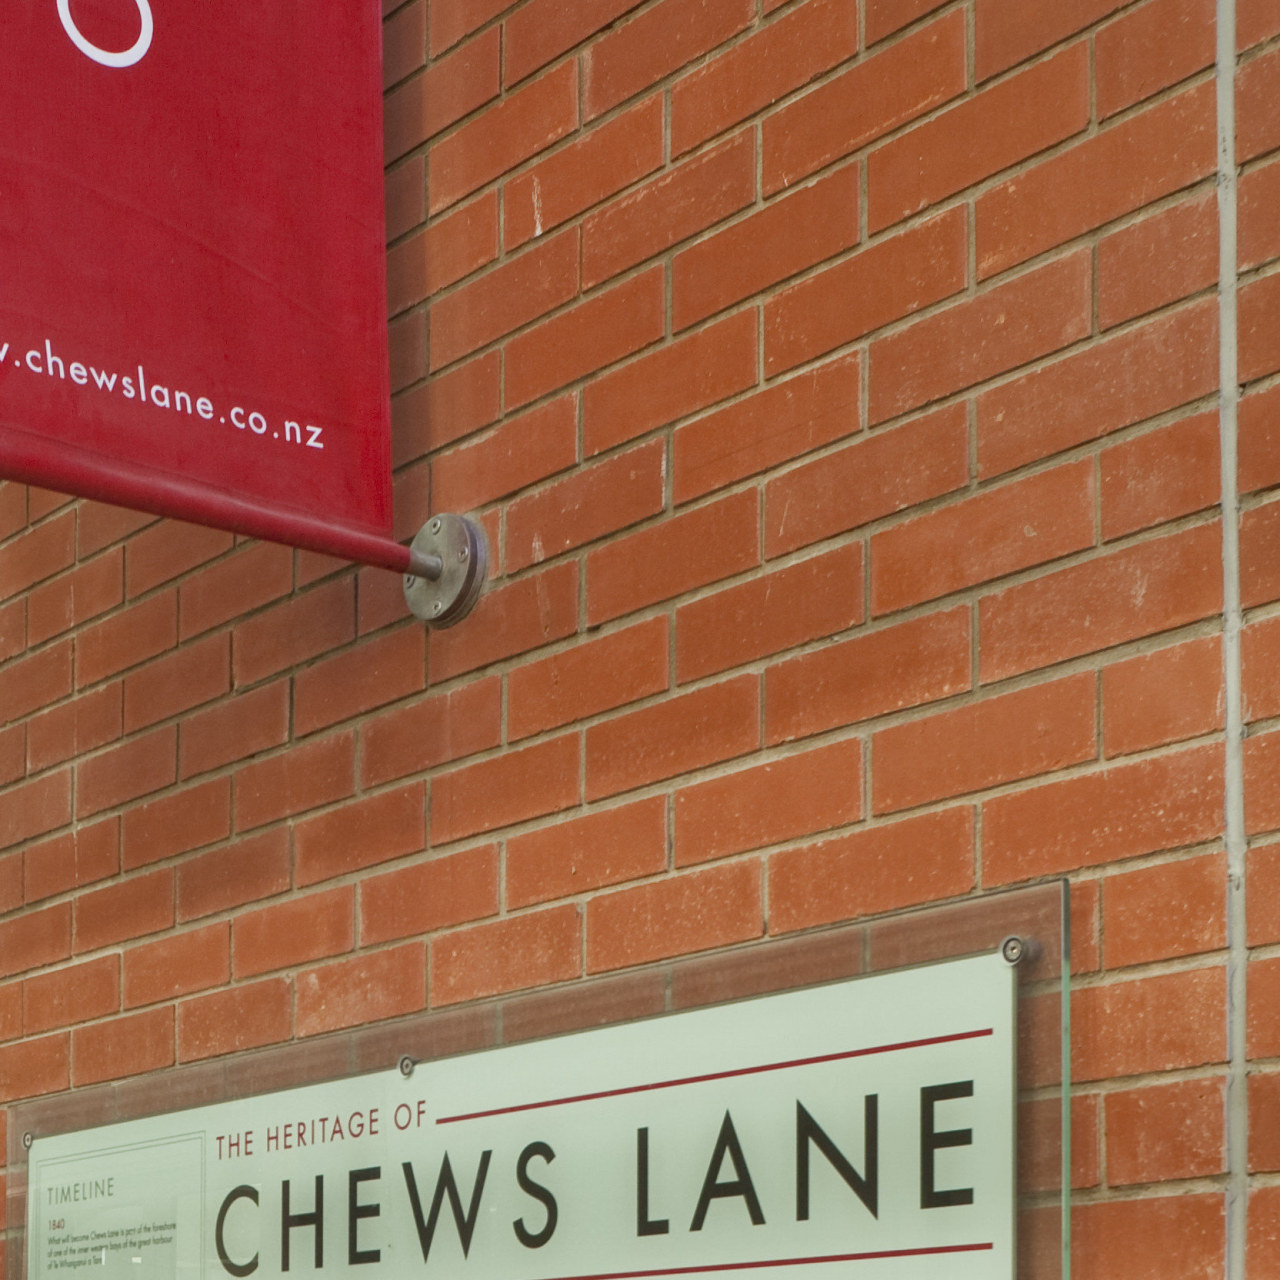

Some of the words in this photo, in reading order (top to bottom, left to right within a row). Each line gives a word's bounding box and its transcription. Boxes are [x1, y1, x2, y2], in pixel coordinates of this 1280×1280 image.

[215, 1130, 254, 1160] THE
[266, 1108, 379, 1153] HERITAGE
[394, 1099, 426, 1131] OF
[47, 1176, 115, 1206] TIMELINE
[215, 1140, 559, 1278] CHEWS
[636, 1079, 974, 1238] LANE
[48, 1218, 65, 1231] 1840
